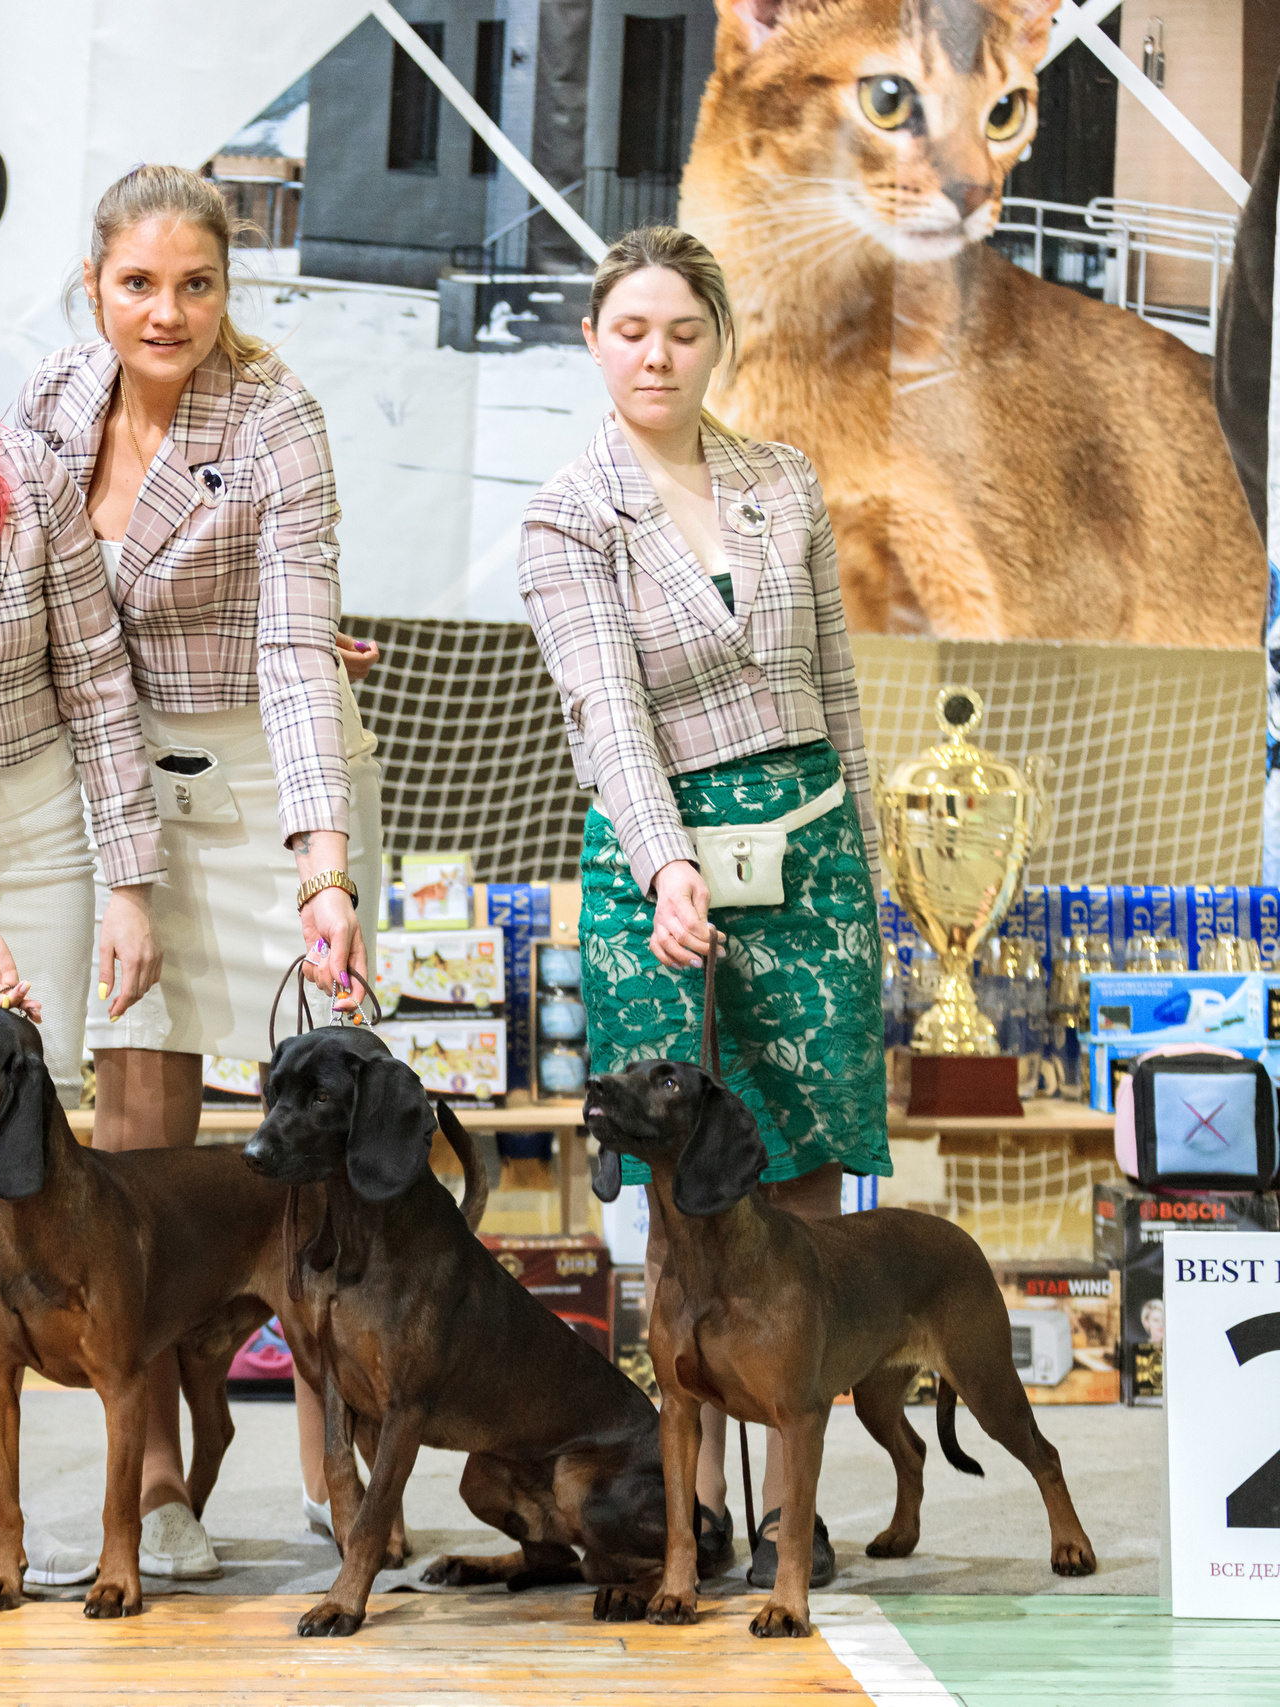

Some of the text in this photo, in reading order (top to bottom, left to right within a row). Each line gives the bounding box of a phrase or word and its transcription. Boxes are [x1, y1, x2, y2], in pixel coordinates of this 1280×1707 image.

[1159, 1202, 1226, 1219] BOSCH
[1175, 1258, 1265, 1283] BEST
[1026, 1279, 1114, 1296] STARWIND
[1210, 1562, 1245, 1577] ВСЕ
